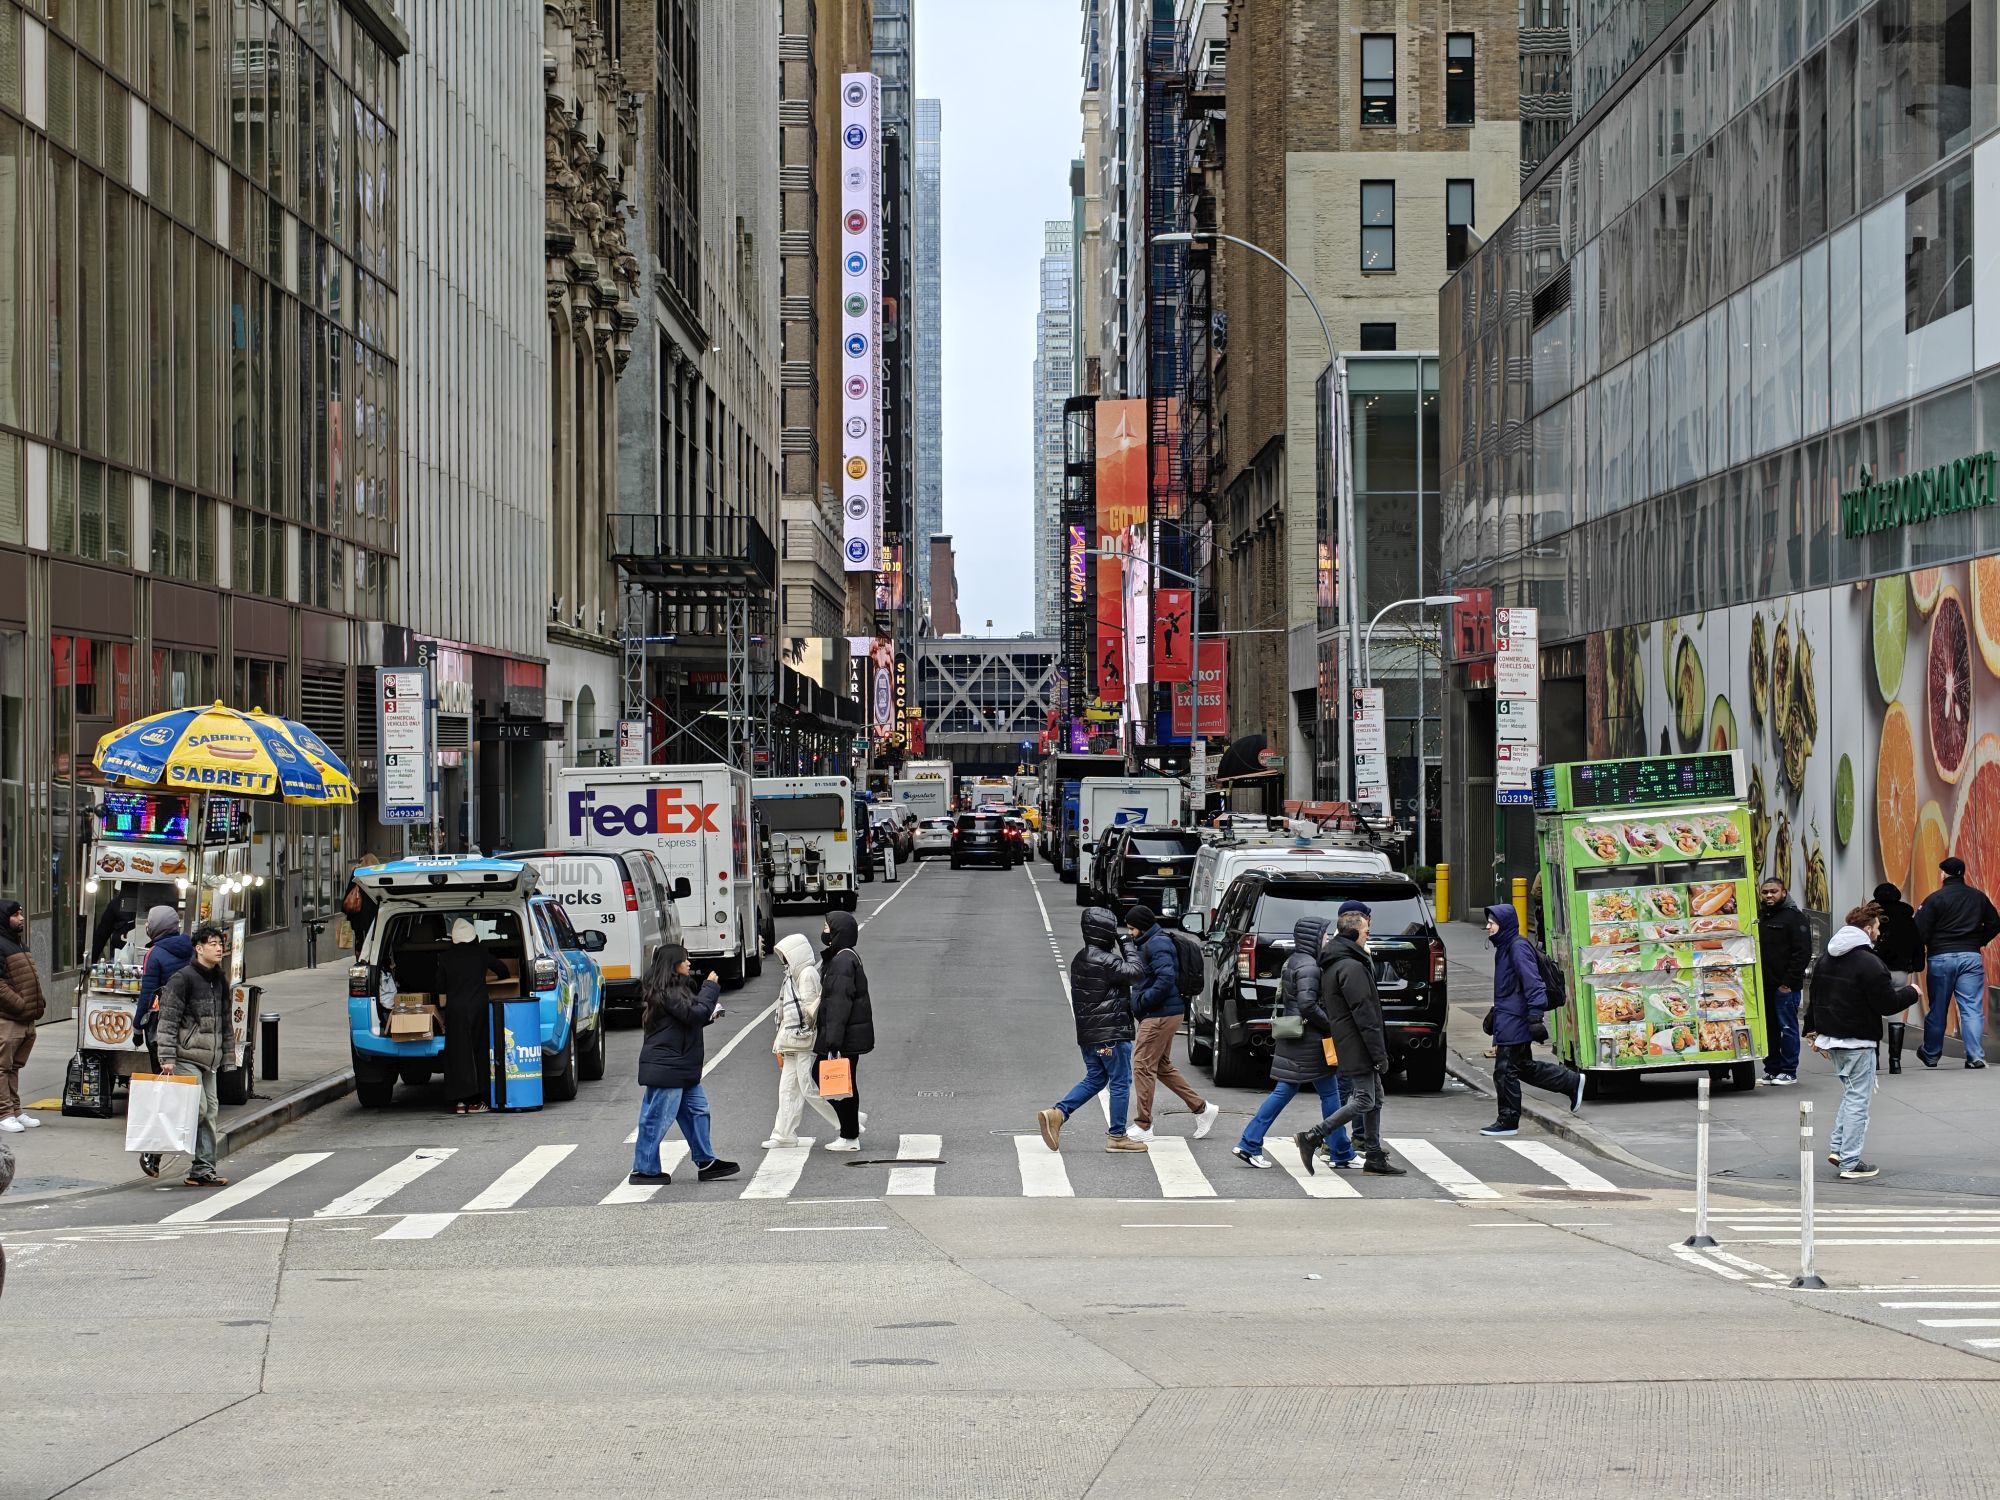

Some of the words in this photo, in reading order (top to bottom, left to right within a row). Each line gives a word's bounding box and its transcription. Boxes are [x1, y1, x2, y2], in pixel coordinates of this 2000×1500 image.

[882, 358, 893, 524] SQUARE
[1500, 640, 1507, 651] 3
[387, 702, 395, 713] 3
[896, 662, 906, 743] SHOCARD
[1177, 696, 1221, 707] EXRESS
[1500, 701, 1508, 714] 6
[1356, 711, 1362, 720] 3
[500, 726, 531, 737] FIVE
[187, 733, 252, 748] SABRETT
[388, 755, 396, 766] 6
[1358, 755, 1363, 764] 6
[171, 765, 272, 788] SABRETT
[326, 784, 348, 798] ETT
[903, 791, 937, 801] Signature
[568, 788, 721, 836] FedEx
[657, 838, 697, 852] Express
[549, 889, 603, 906] ucks
[600, 913, 616, 924] 39
[518, 1045, 542, 1059] nuu
